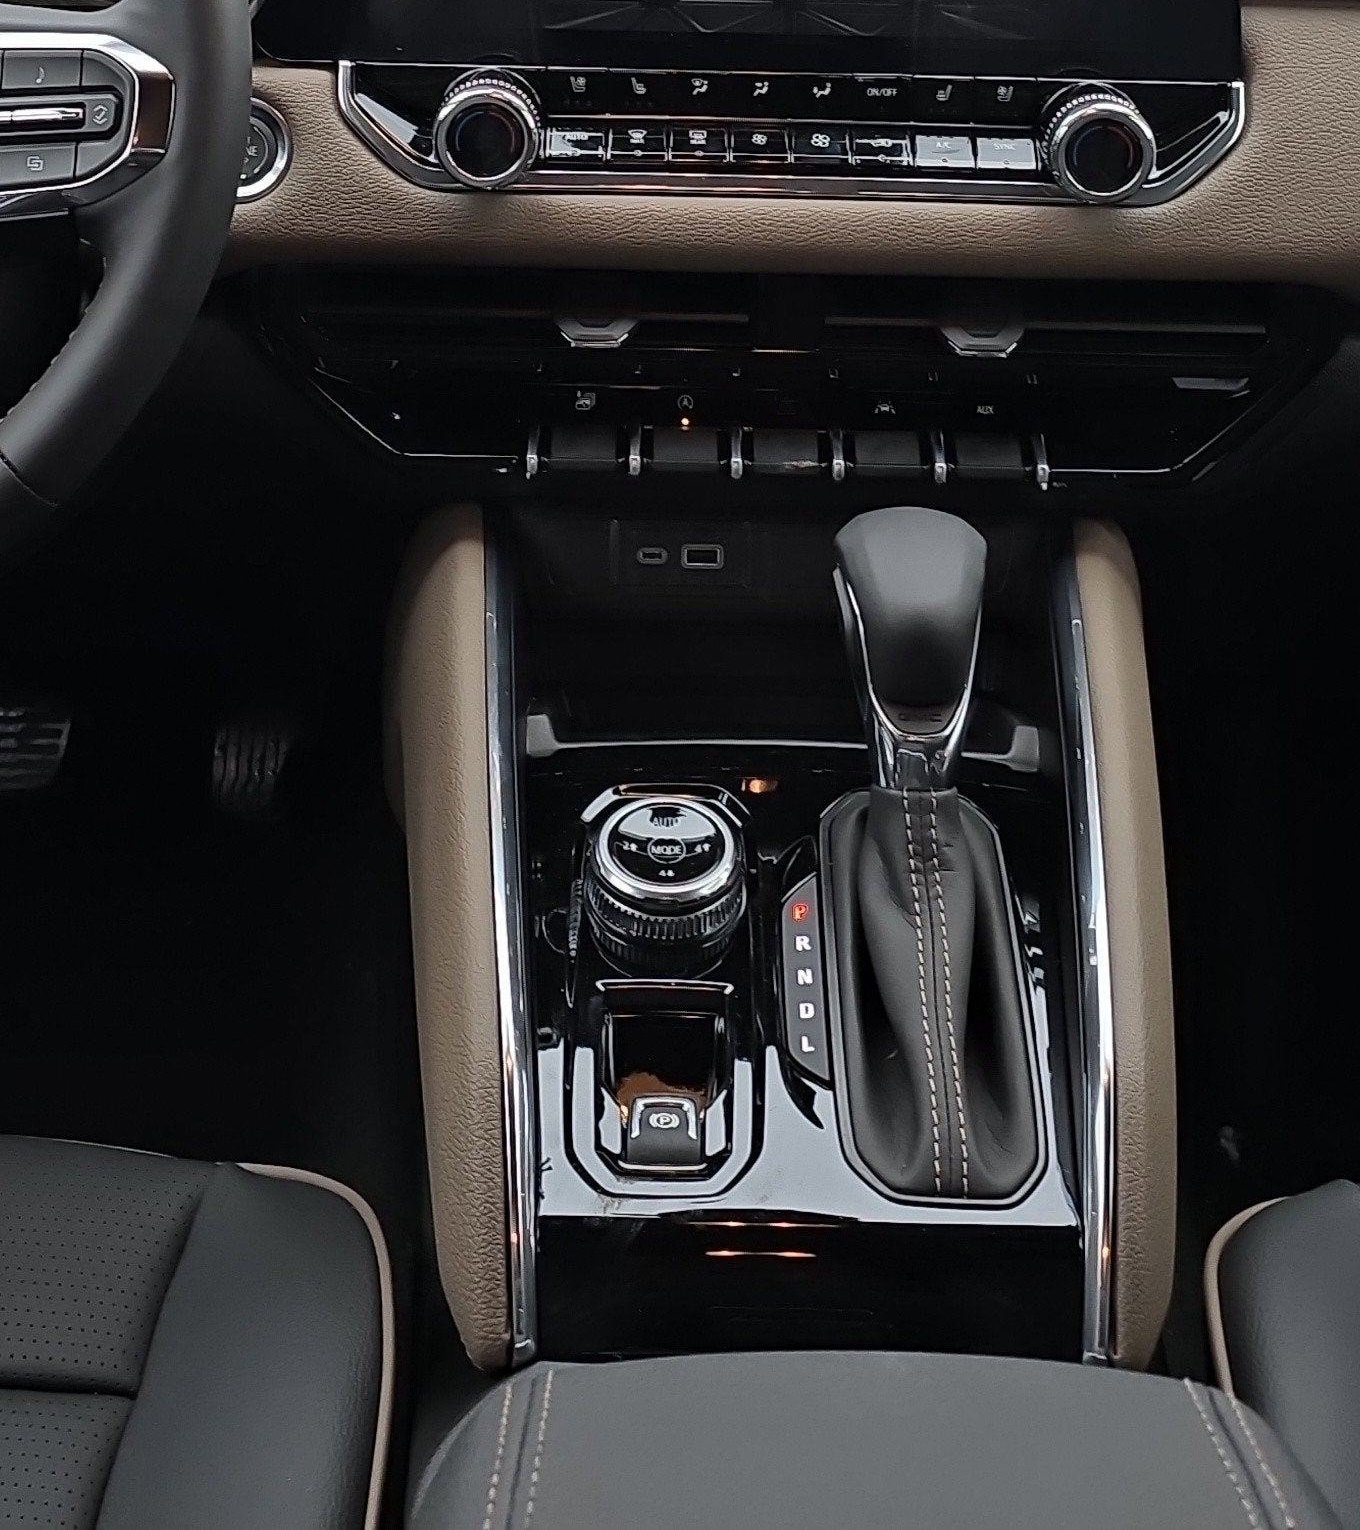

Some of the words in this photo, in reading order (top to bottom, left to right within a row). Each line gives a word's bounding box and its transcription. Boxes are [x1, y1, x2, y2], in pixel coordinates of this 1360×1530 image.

[867, 85, 897, 97] ON/OFF
[652, 816, 681, 827] AUTO
[651, 844, 682, 856] MODE
[792, 903, 808, 920] P
[795, 934, 812, 951] R
[796, 968, 813, 985] N
[798, 1002, 816, 1019] D
[800, 1035, 816, 1052] L
